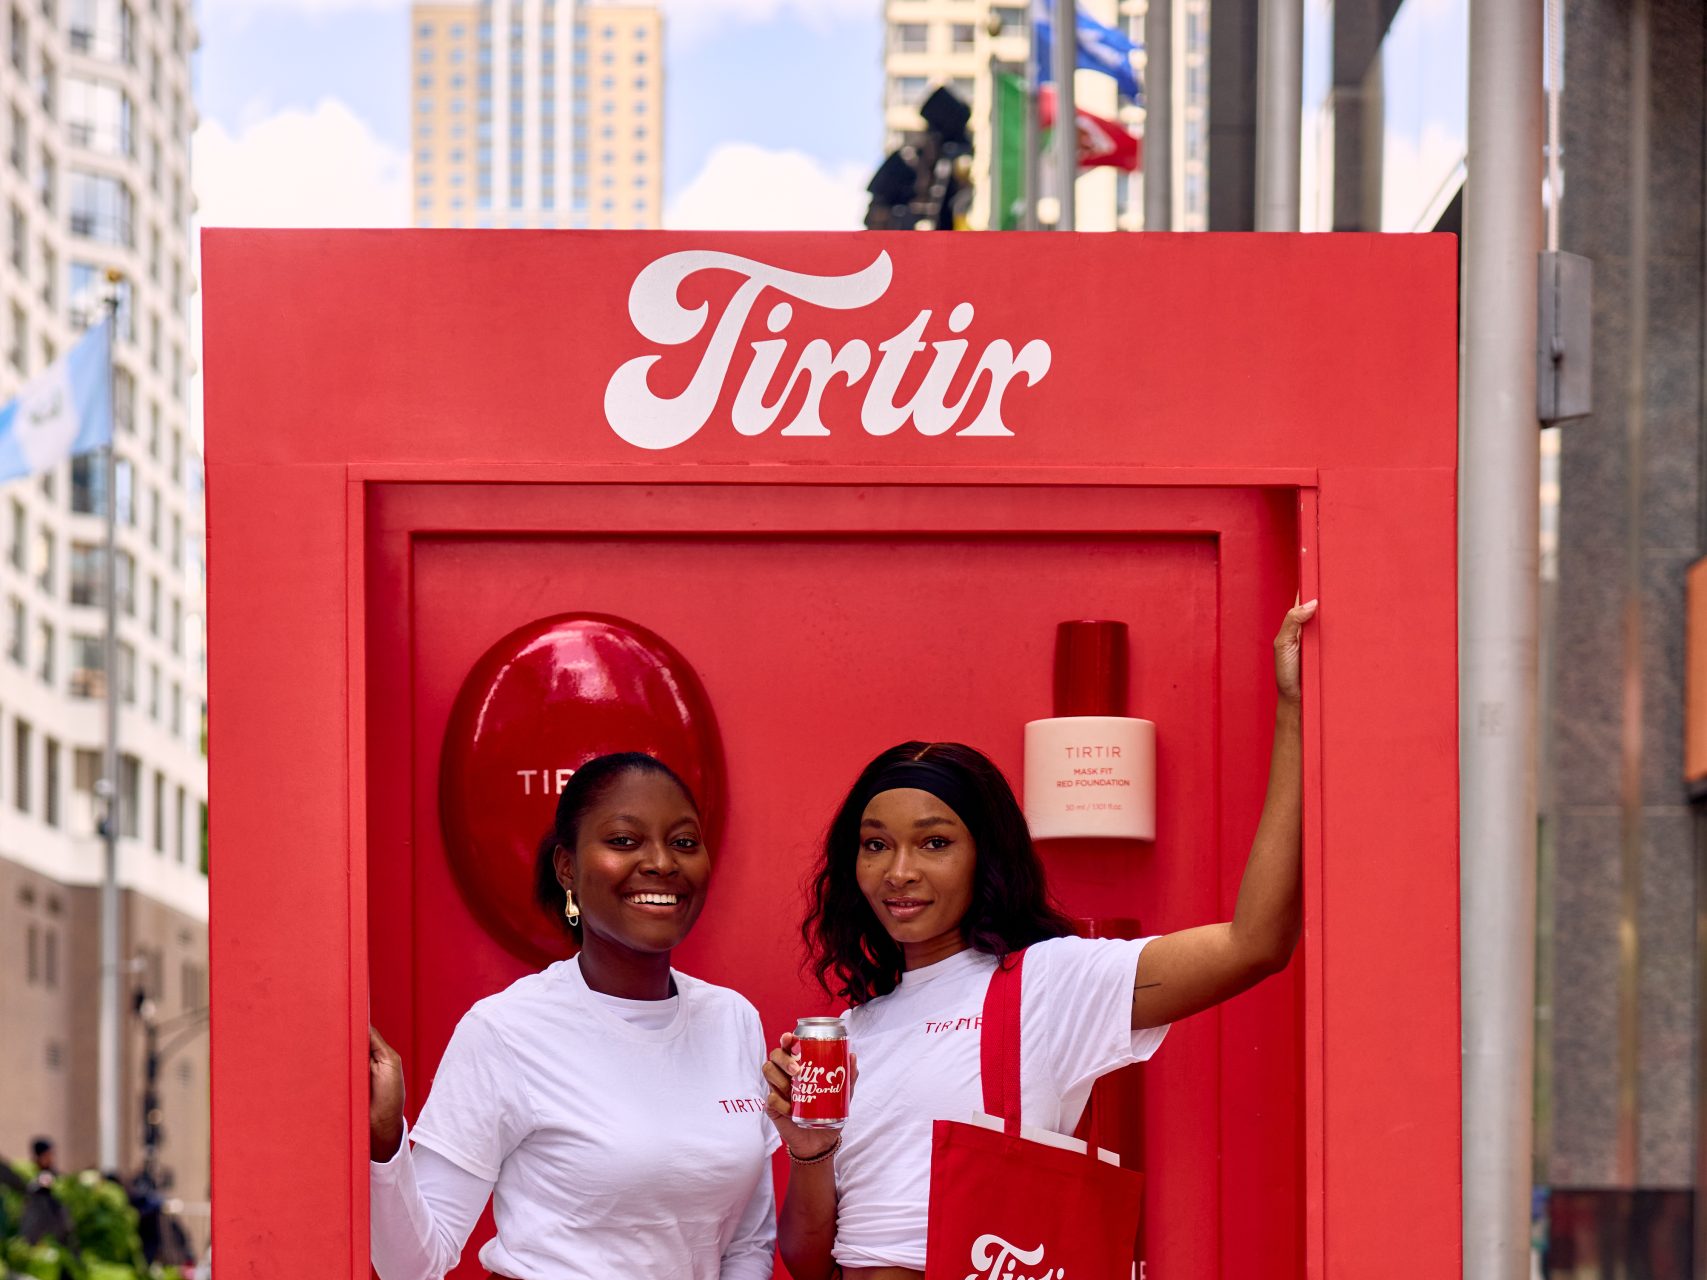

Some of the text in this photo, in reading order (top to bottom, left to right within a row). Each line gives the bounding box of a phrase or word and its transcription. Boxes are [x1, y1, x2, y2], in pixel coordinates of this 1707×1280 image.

[603, 249, 1052, 449] Tirtir
[1064, 746, 1122, 759] TIRTIR
[1073, 767, 1114, 776] MASK FIT
[516, 768, 576, 795] TIR
[1056, 779, 1131, 788] RED FOUNDATION
[798, 1083, 840, 1095] World
